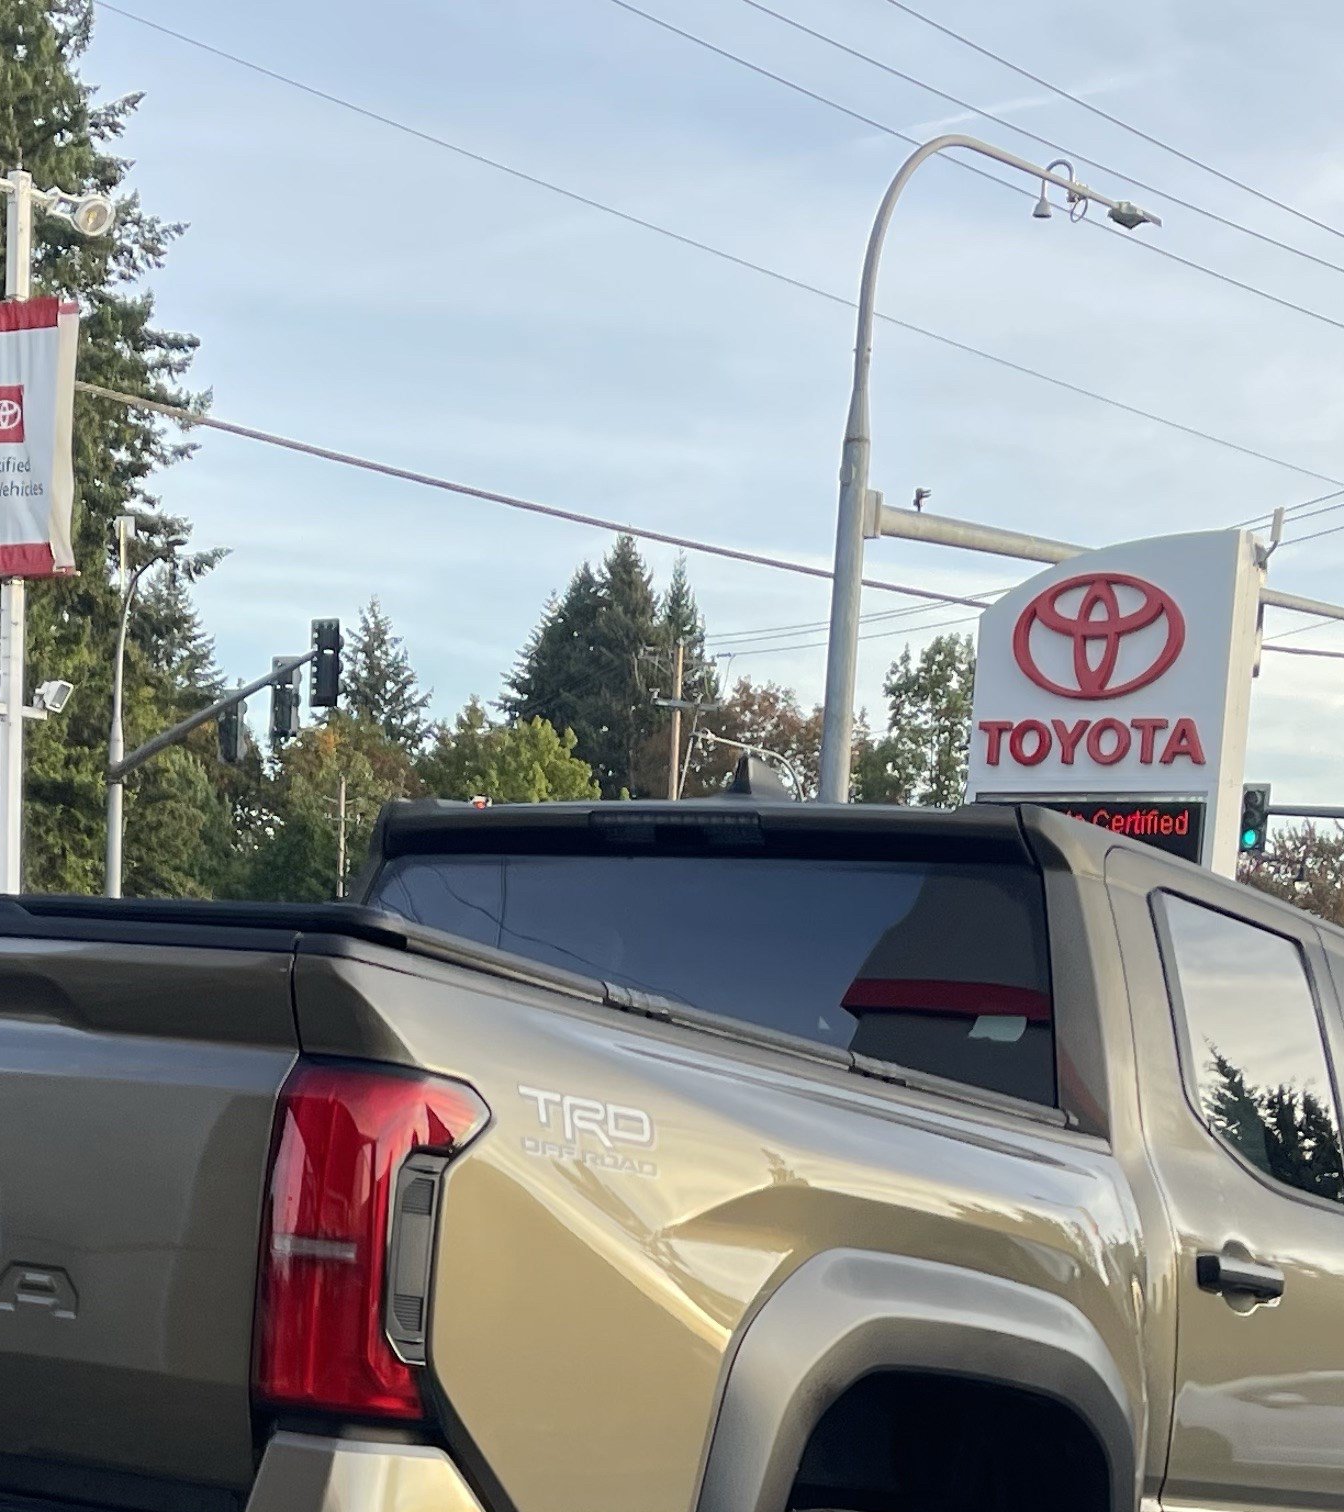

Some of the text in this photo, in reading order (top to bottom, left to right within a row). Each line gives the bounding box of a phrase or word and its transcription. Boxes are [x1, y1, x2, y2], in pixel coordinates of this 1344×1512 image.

[978, 717, 1207, 767] TOYOTA
[1092, 808, 1190, 836] Certified
[517, 1083, 654, 1149] TRD
